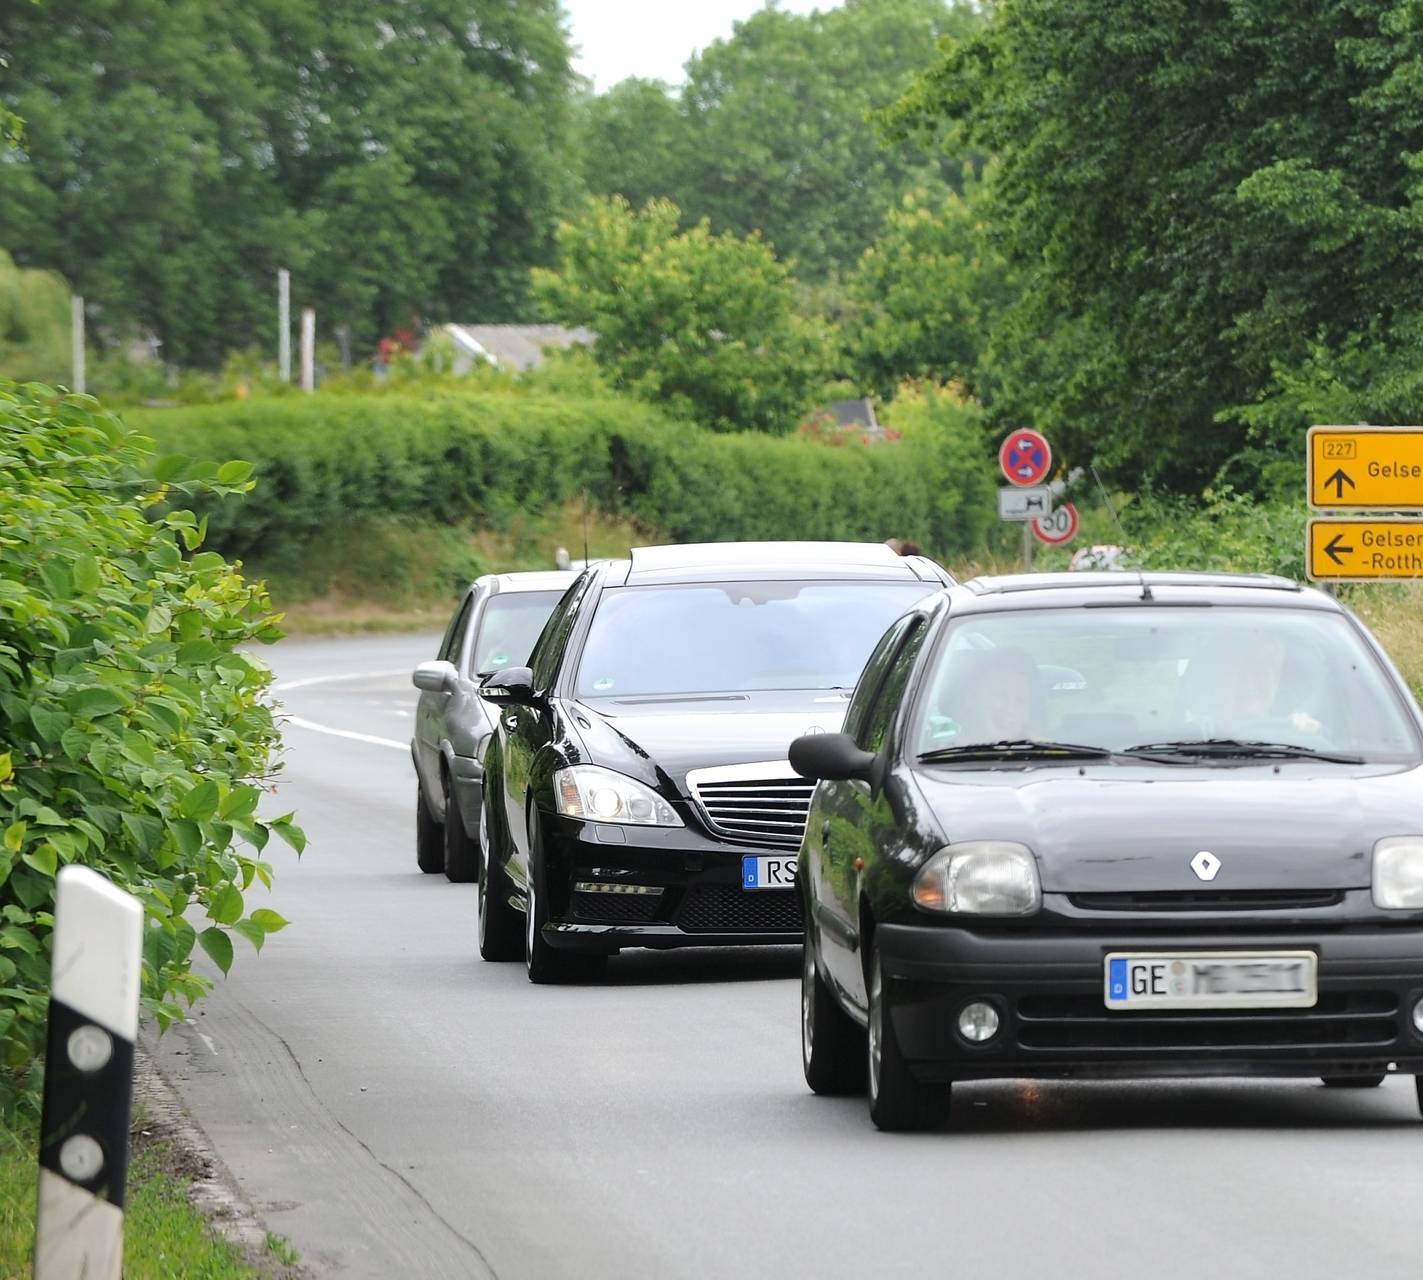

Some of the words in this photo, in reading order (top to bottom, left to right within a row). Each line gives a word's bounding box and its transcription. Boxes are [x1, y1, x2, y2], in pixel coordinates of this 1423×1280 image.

[1326, 443, 1353, 456] 227
[1042, 508, 1069, 533] 50
[767, 860, 798, 884] RS
[1131, 965, 1167, 995] GE
